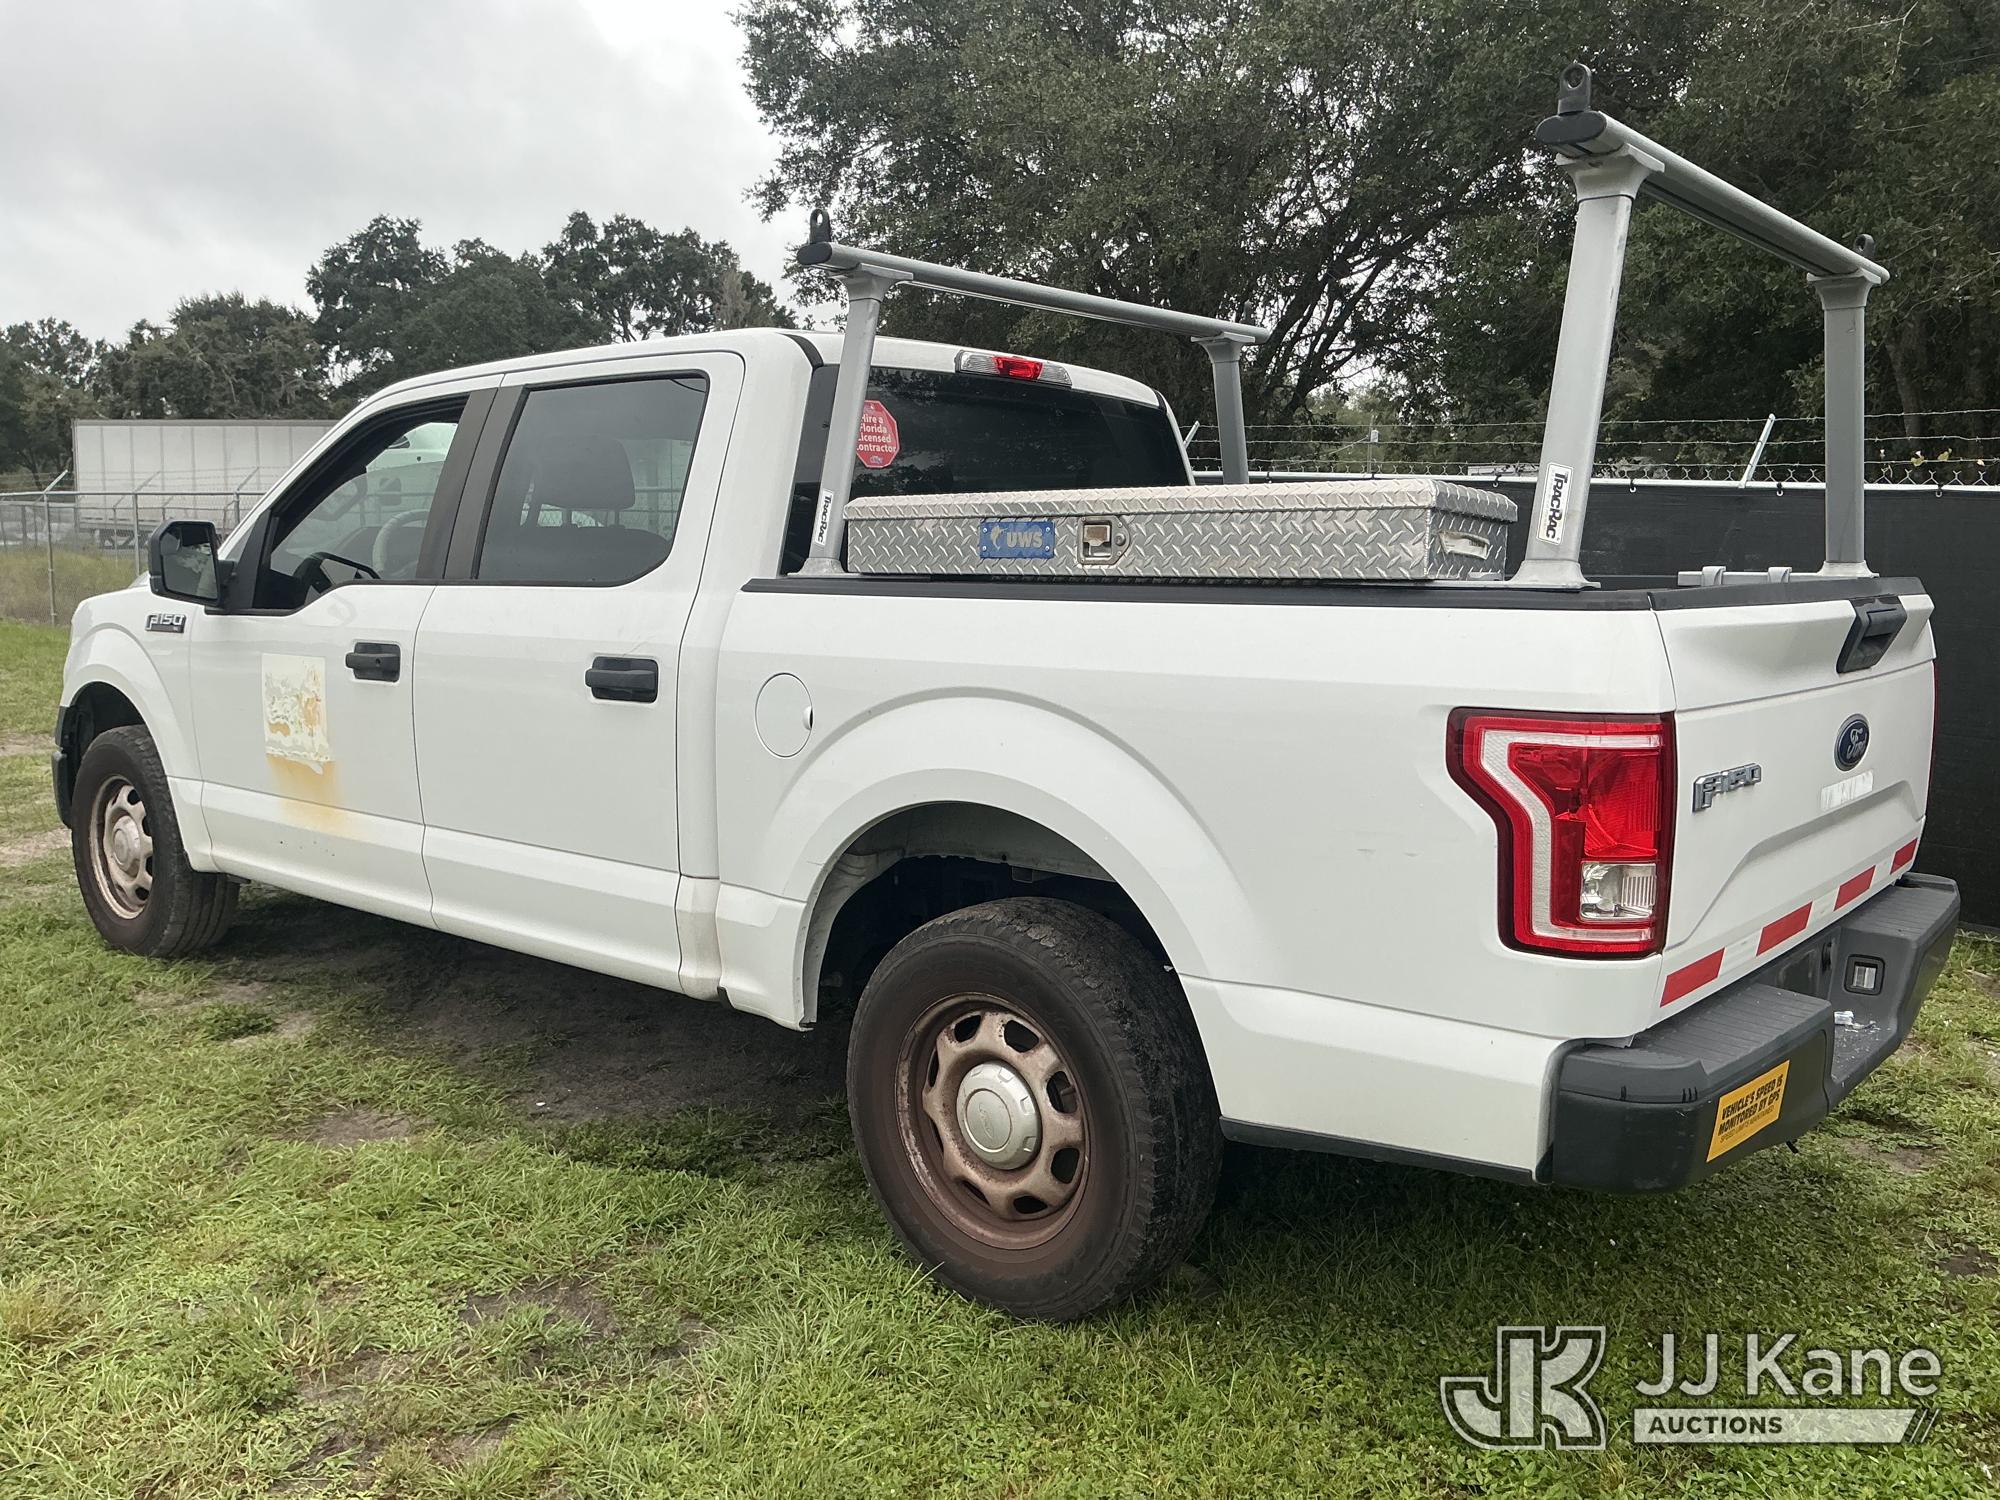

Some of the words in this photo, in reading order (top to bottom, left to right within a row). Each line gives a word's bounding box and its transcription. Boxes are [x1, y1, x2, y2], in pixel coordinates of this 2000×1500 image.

[878, 416, 884, 424] a
[856, 443, 897, 453] ontractor
[1006, 531, 1043, 548] UWS
[1846, 727, 1868, 759] Ford
[1721, 1091, 1756, 1121] VEHICLE'S
[1755, 1078, 1777, 1100] SPEED
[1776, 1073, 1784, 1088] IS
[1718, 1102, 1758, 1136] MONITORED
[1758, 1098, 1767, 1112] BY
